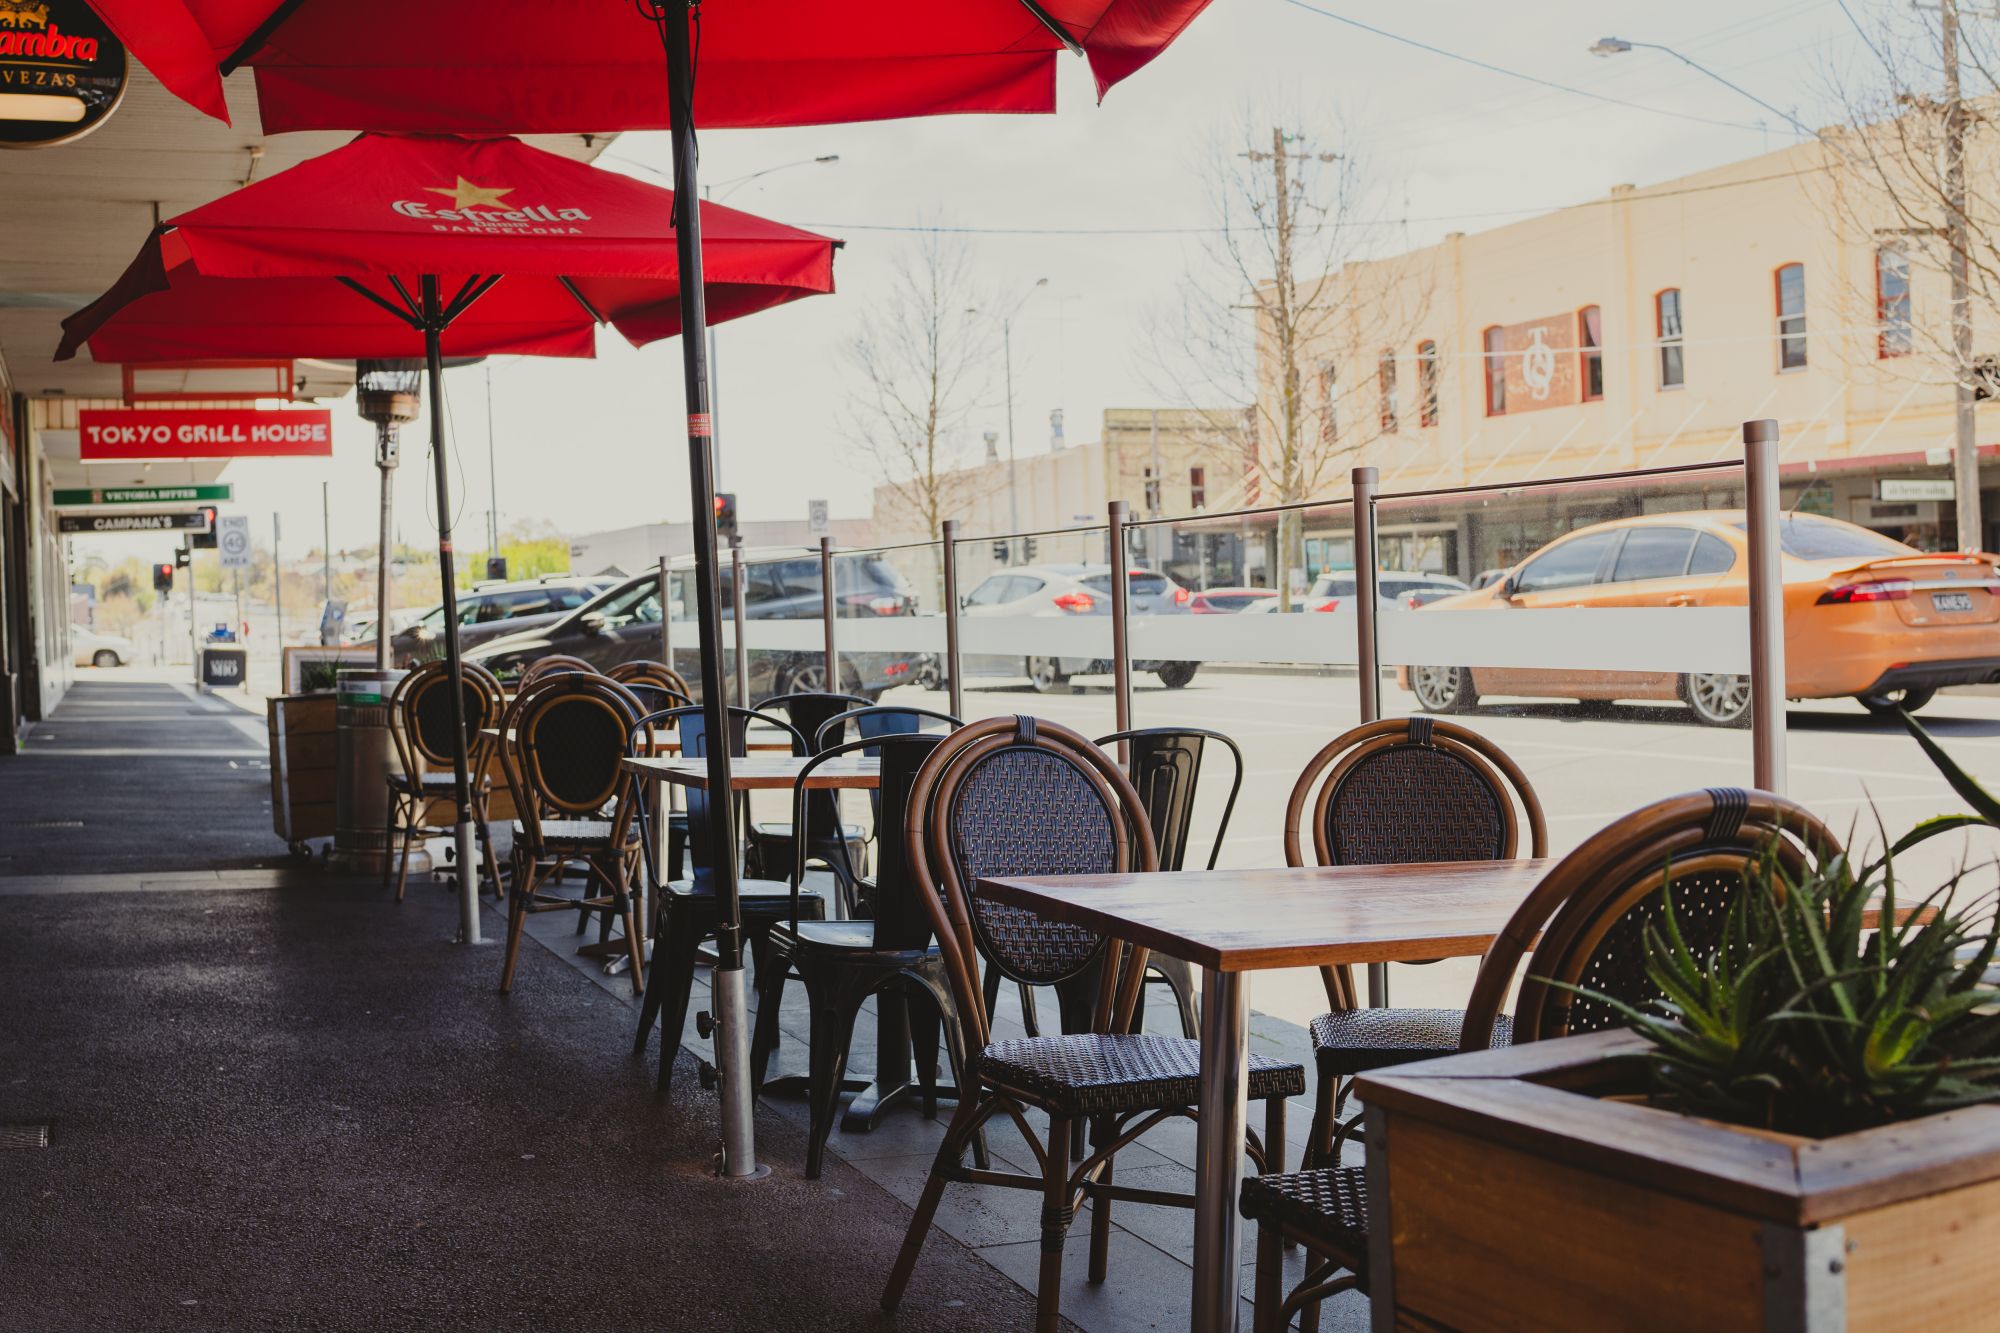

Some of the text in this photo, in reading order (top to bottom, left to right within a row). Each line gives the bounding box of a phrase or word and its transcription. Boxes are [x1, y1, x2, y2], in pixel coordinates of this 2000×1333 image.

[3, 70, 76, 88] VEZAS
[391, 199, 592, 222] Estrella
[431, 224, 583, 234] BARCELONA
[473, 220, 530, 228] Damm
[87, 425, 171, 444] TOKYO
[251, 423, 327, 442] HOUSE
[105, 488, 198, 501] VICTORIA BITTER
[93, 516, 173, 530] CAMPANA'S
